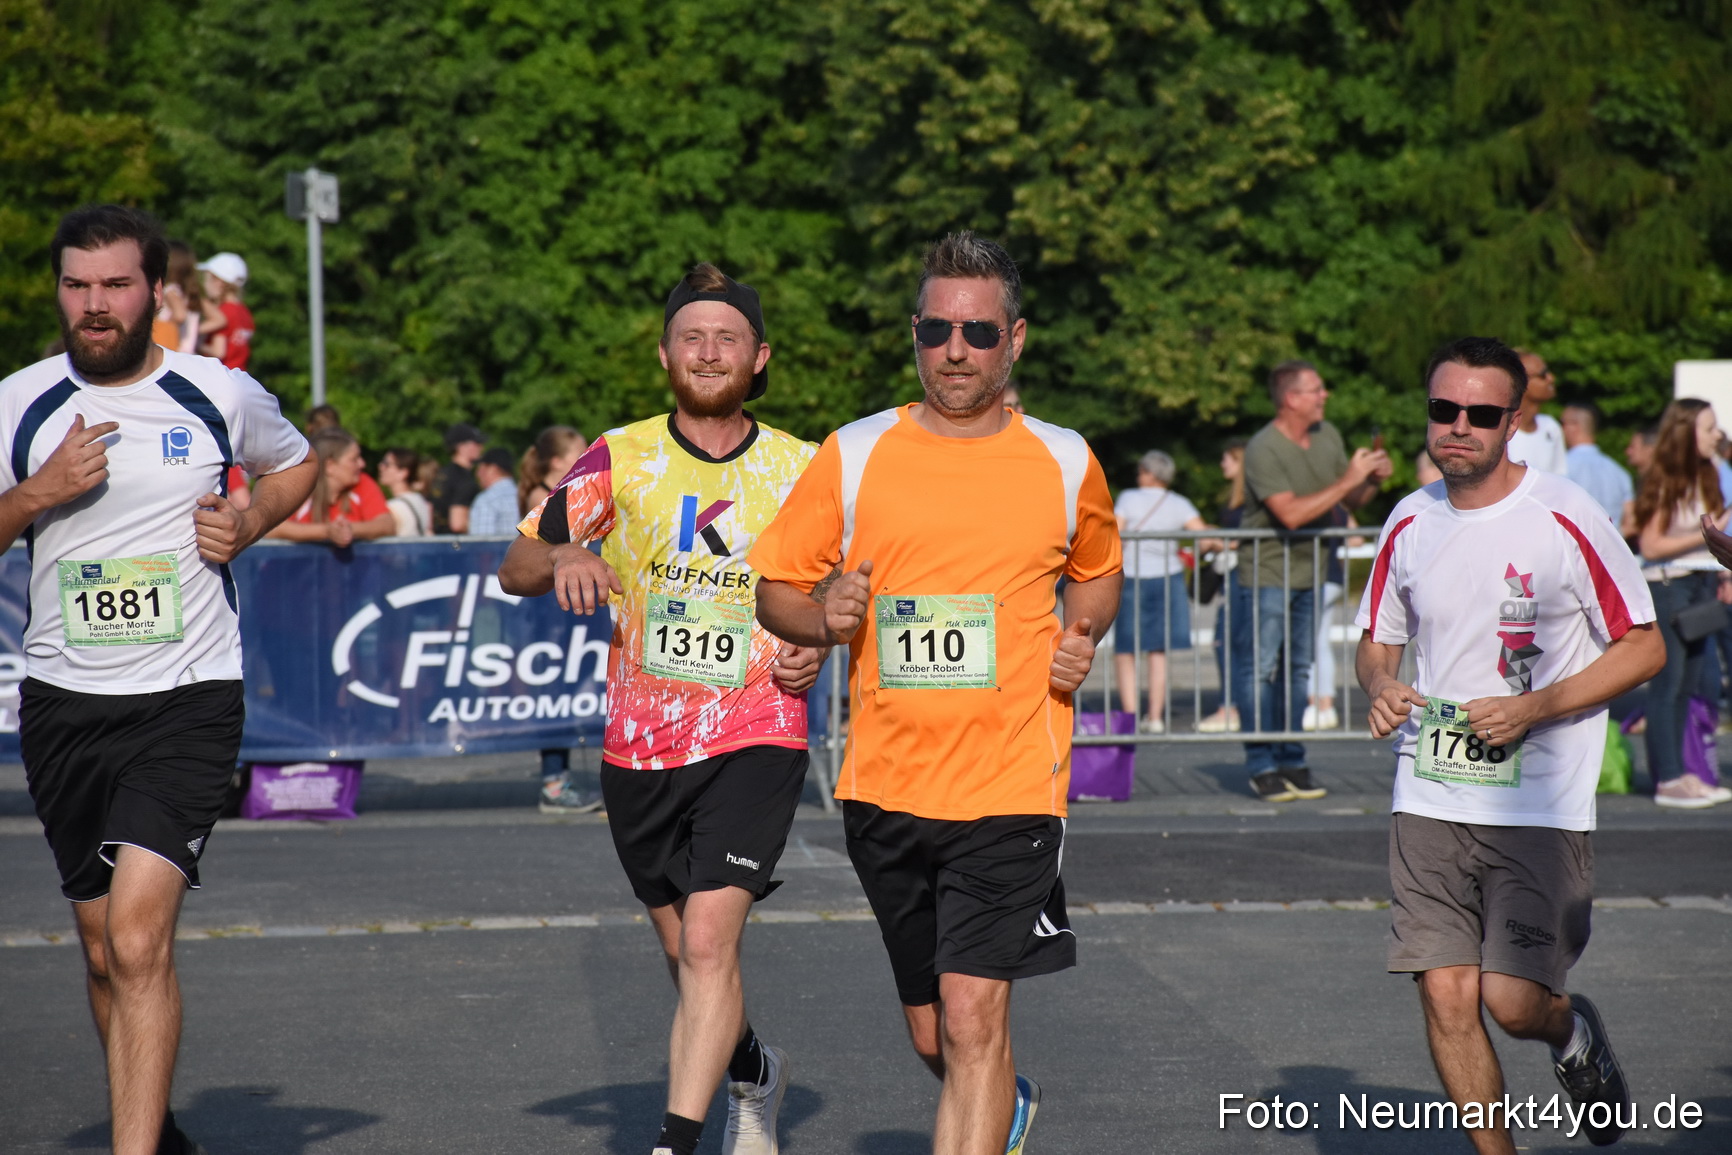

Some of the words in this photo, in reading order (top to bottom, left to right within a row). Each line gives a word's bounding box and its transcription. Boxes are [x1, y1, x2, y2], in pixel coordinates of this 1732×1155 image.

[163, 457, 190, 466] POHL
[149, 577, 171, 586] 2019
[651, 561, 750, 590] KÜFNER
[673, 586, 690, 594] UND
[693, 588, 725, 597] TIEFBAU
[728, 591, 750, 599] GMBH
[75, 587, 160, 621] 1881
[87, 622, 123, 631] Taucher
[127, 620, 155, 628] Moritz
[890, 612, 934, 622] firmenlauf
[963, 620, 987, 628] 2019
[725, 626, 745, 635] 2019
[656, 625, 734, 663] 1319
[898, 629, 965, 662] 110
[666, 663, 682, 672] Hoch-
[683, 666, 693, 674] und
[695, 669, 716, 677] Tiefbau
[669, 657, 688, 666] Hartl
[690, 660, 714, 670] Kevin
[899, 664, 930, 673] Kröber
[933, 664, 965, 672] Robert
[1430, 728, 1506, 763] 1788
[1434, 758, 1467, 770] Schaffer
[1469, 764, 1496, 772] Daniel
[726, 852, 760, 870] hummel
[1506, 918, 1557, 944] Reebok
